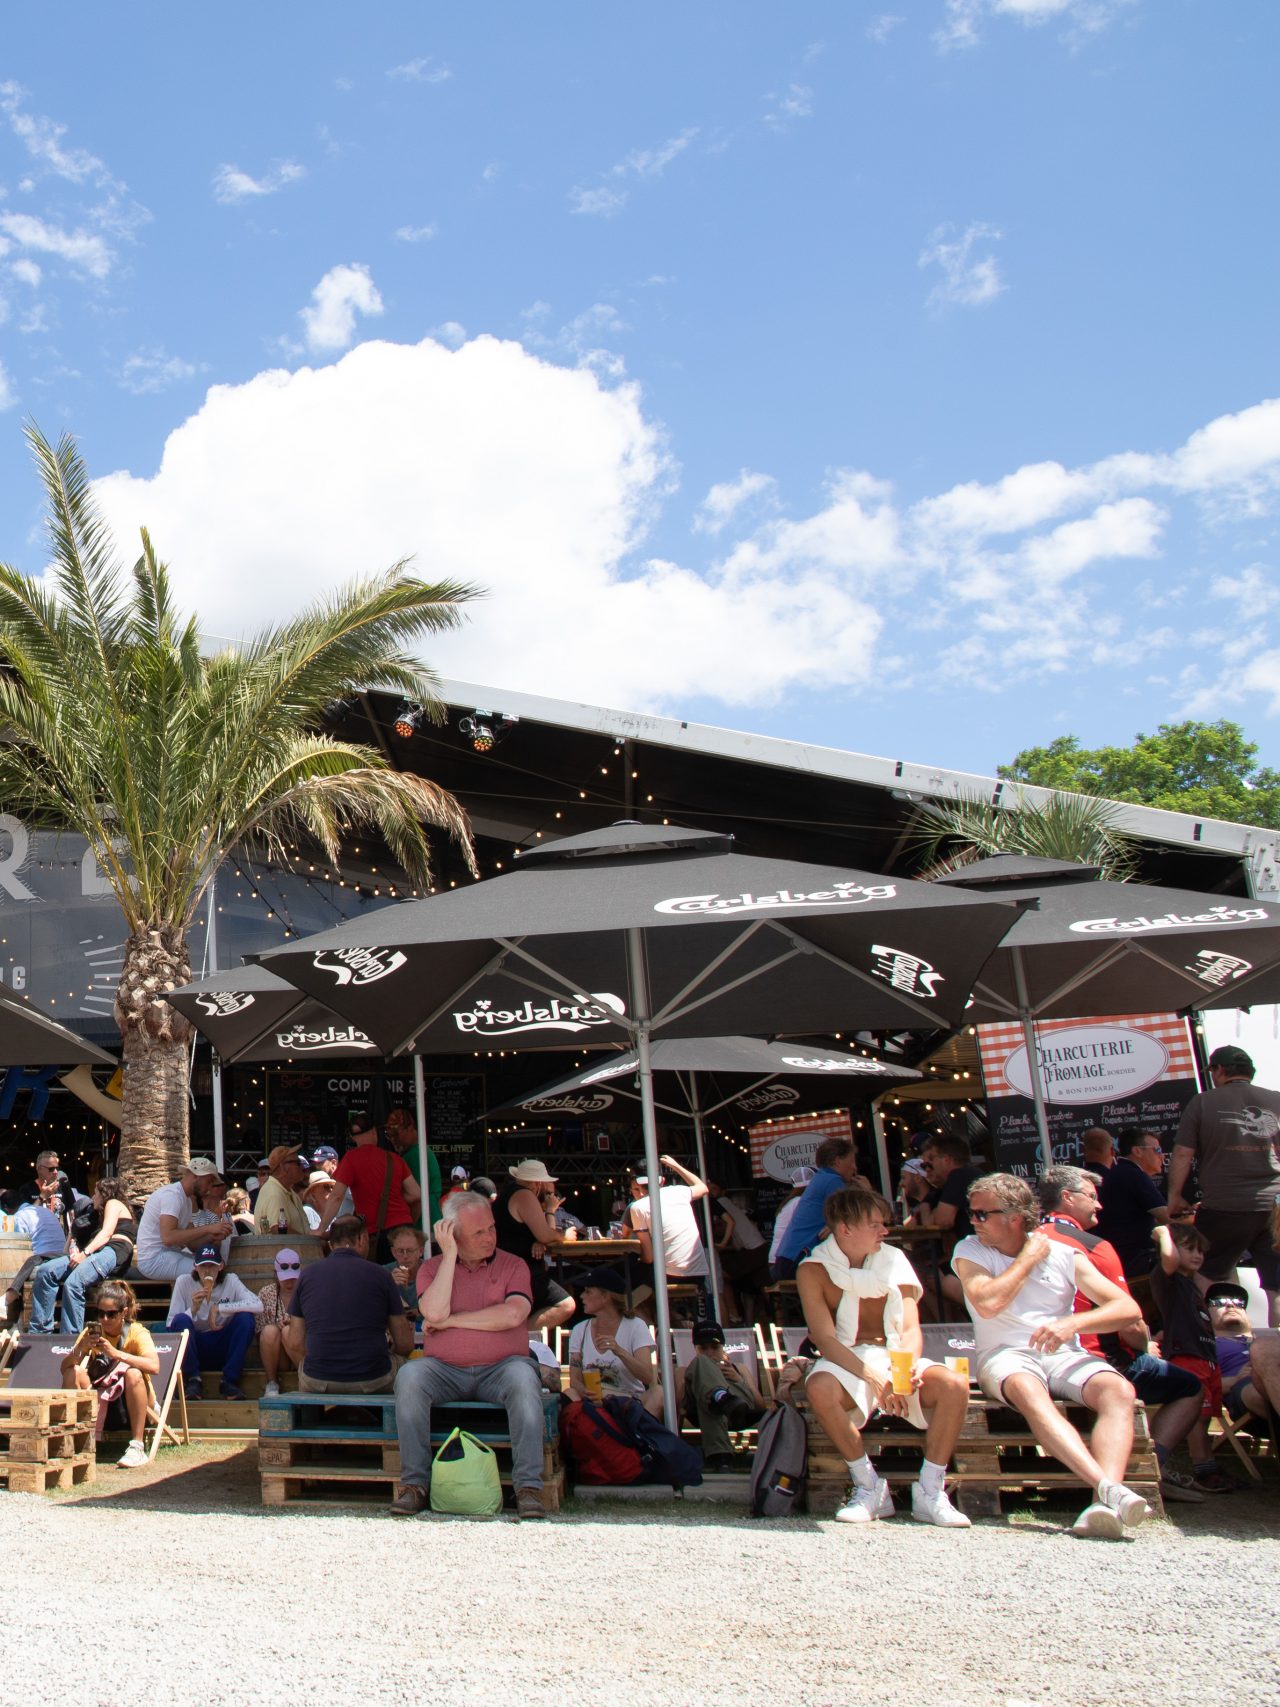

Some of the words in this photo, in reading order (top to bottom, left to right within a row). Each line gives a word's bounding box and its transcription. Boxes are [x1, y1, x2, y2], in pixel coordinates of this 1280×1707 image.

[654, 883, 897, 914] Carlsberg
[1069, 906, 1269, 932] Carlsberg
[1045, 1062, 1106, 1083] FROMAGE
[327, 1078, 405, 1093] COMPIR
[1084, 1084, 1115, 1093] PINARD
[1010, 1164, 1029, 1176] VIN
